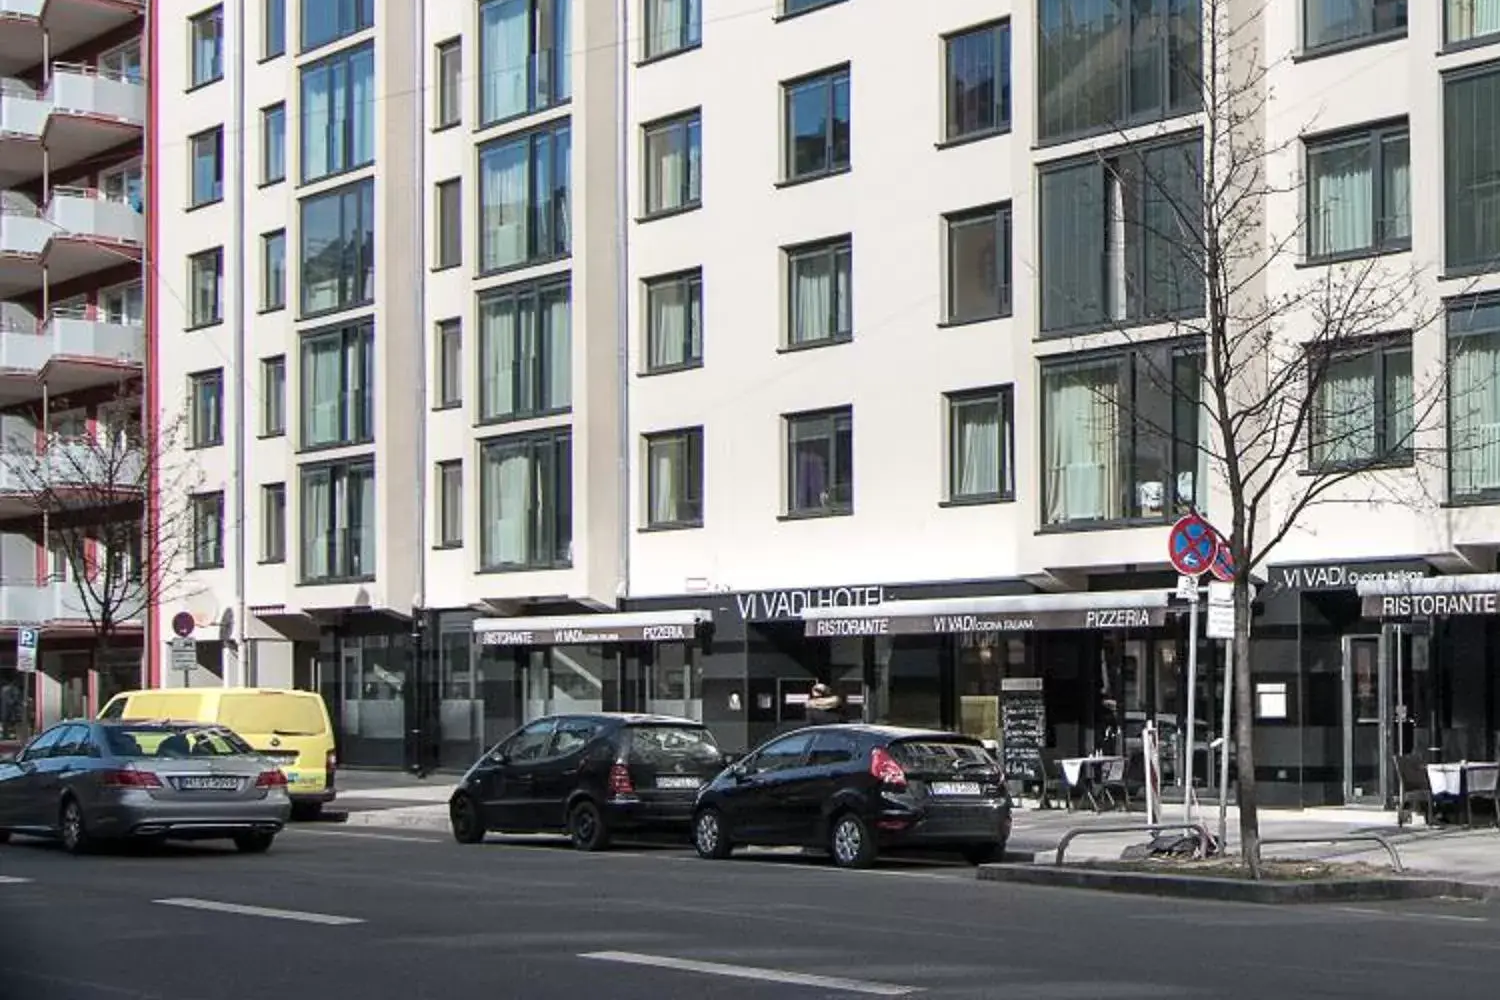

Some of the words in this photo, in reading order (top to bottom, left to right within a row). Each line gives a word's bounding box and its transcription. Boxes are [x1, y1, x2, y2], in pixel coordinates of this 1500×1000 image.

[1283, 569, 1300, 588] VI
[1304, 567, 1346, 586] VADI
[737, 594, 757, 618] VI
[761, 591, 811, 618] VADI
[1383, 594, 1497, 615] RISTORANTE
[817, 618, 889, 636] RISTORANTE
[1086, 609, 1149, 627] PIZZERIA
